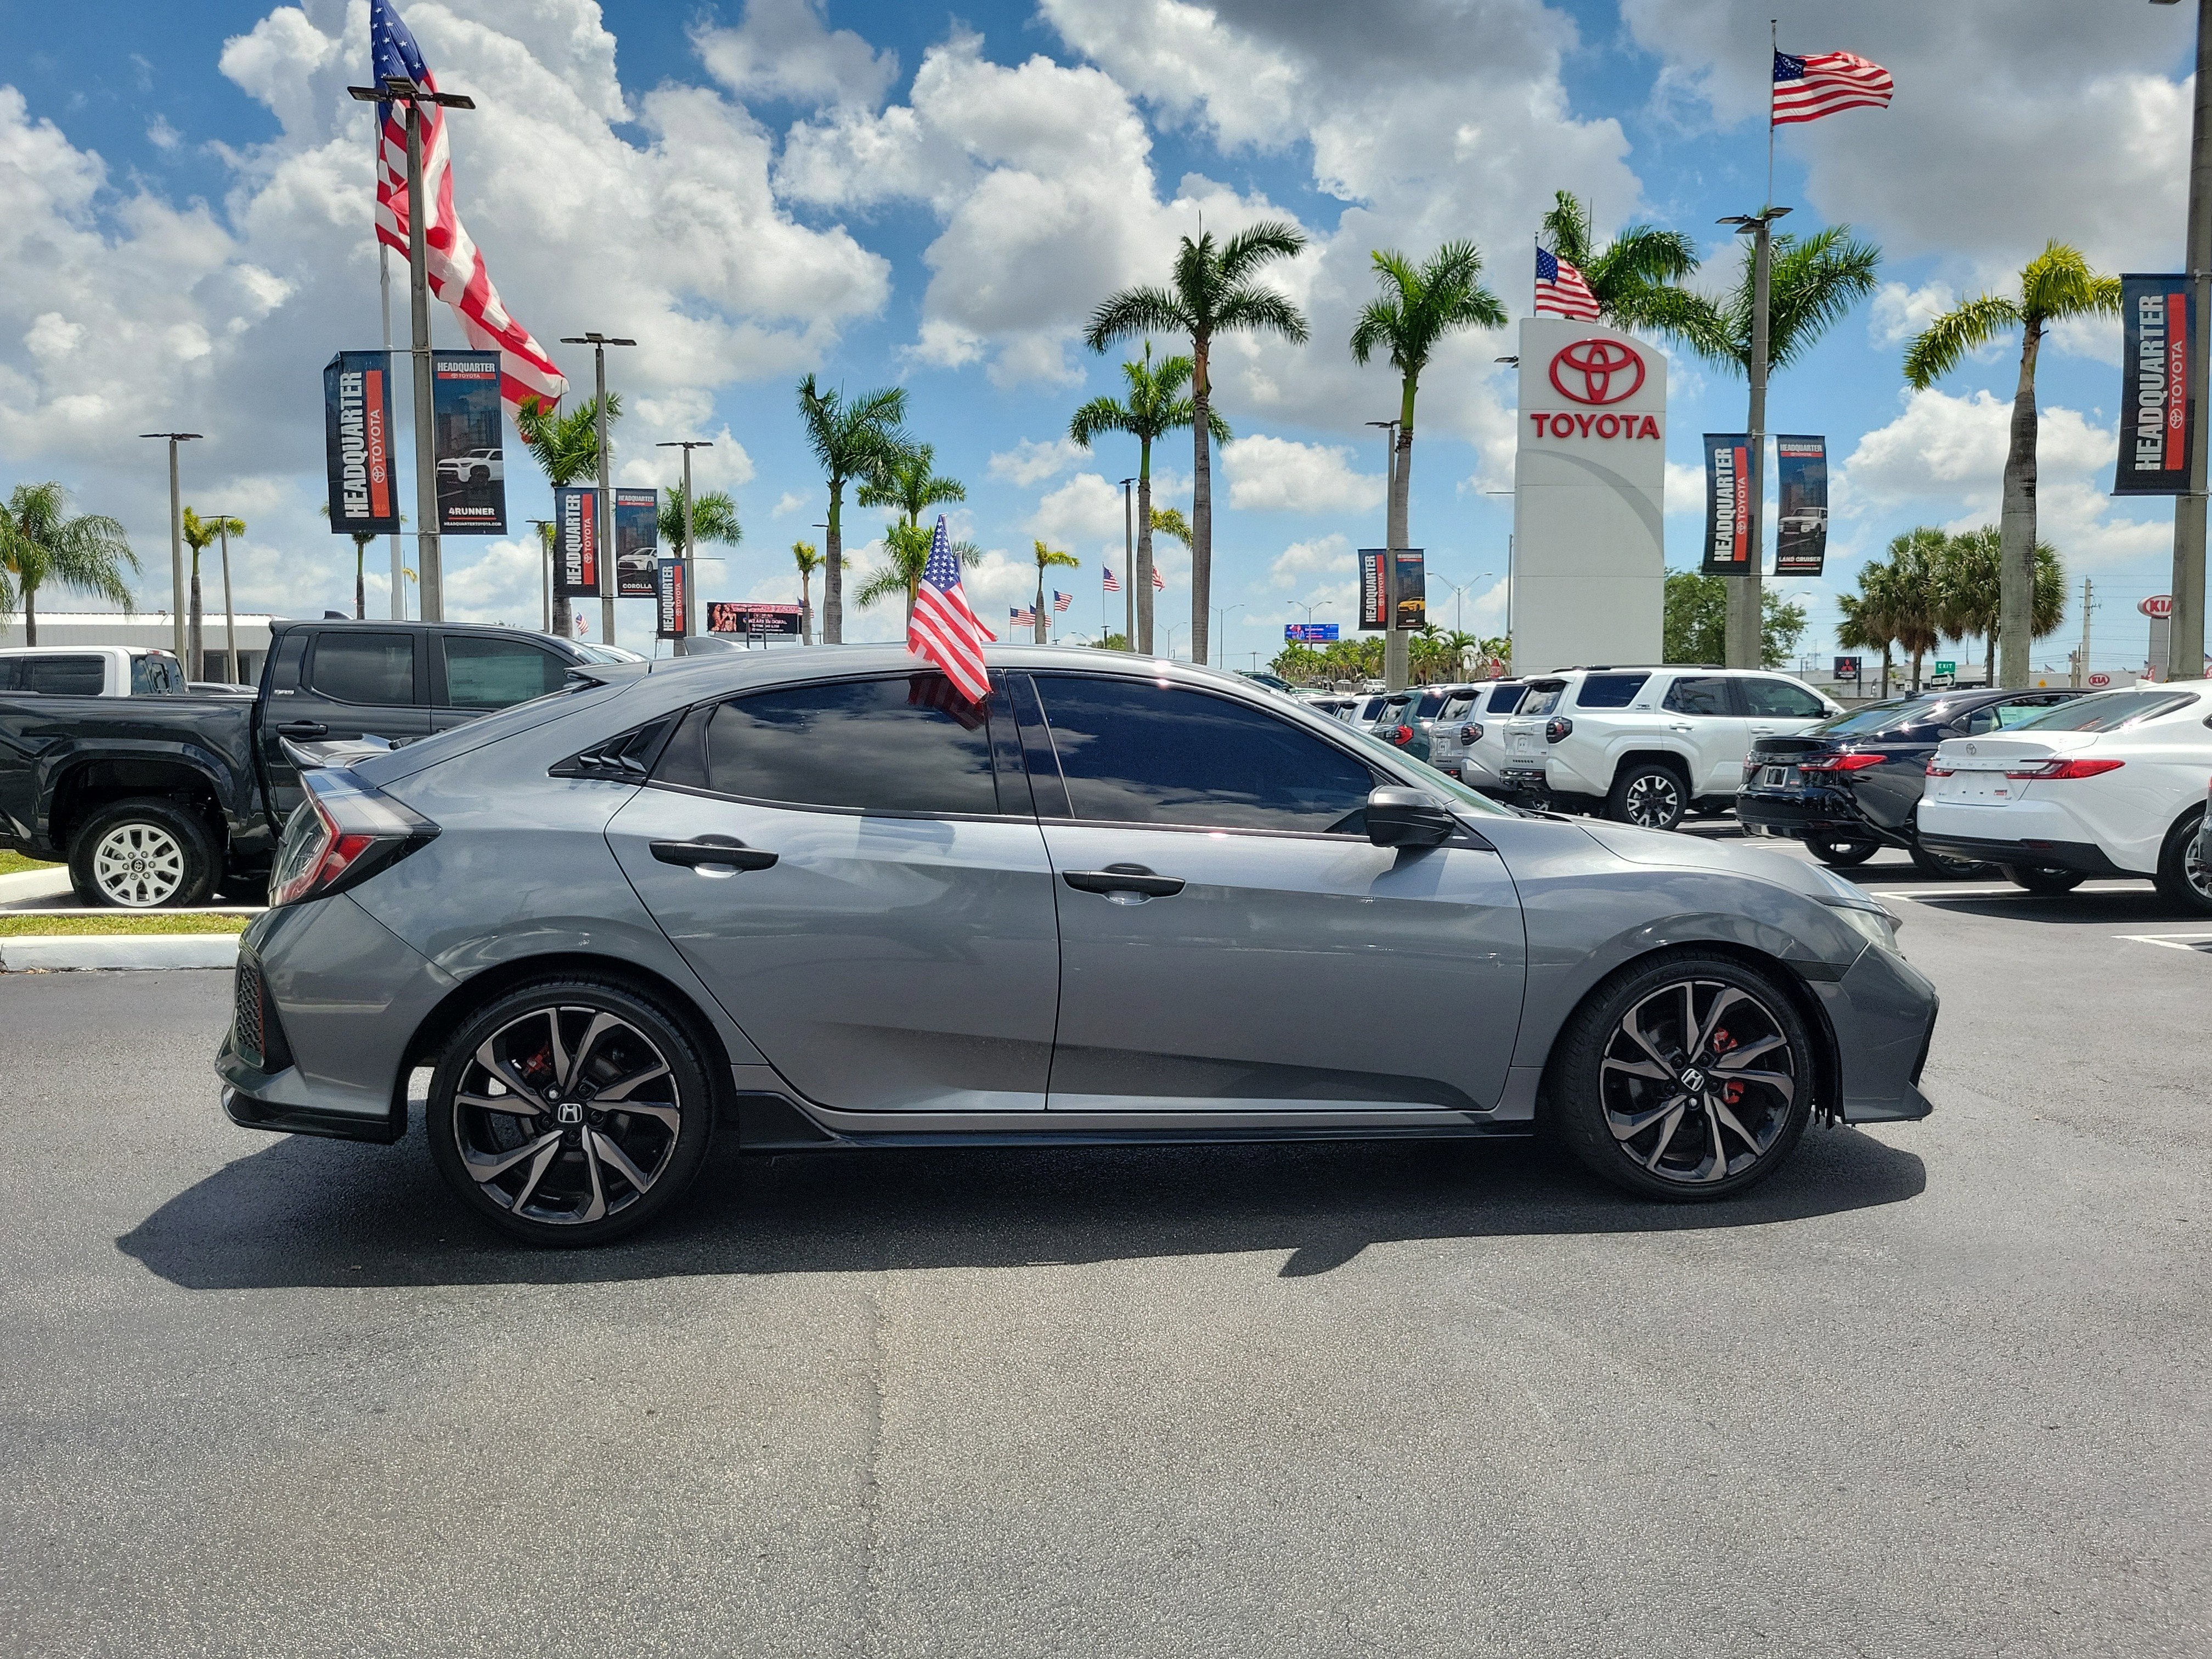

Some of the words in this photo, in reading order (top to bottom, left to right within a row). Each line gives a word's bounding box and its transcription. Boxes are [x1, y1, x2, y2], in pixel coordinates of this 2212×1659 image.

[437, 362, 495, 373] HEADQUARTER
[2134, 295, 2168, 471] HEADQUARTER
[2171, 340, 2183, 407] TOYOTA
[340, 371, 370, 518] HEADQUARTER
[370, 409, 383, 465] TOYOTA
[1530, 413, 1660, 439] TOYOTA
[1780, 444, 1822, 452] HEADQUARTER
[1713, 448, 1736, 562] HEADQUARTER
[1737, 477, 1746, 520] TOYOTA
[566, 494, 583, 585] HEADQUARTER
[662, 566, 675, 631] HEADQUARTER
[1365, 555, 1378, 623] HEADQUARTER
